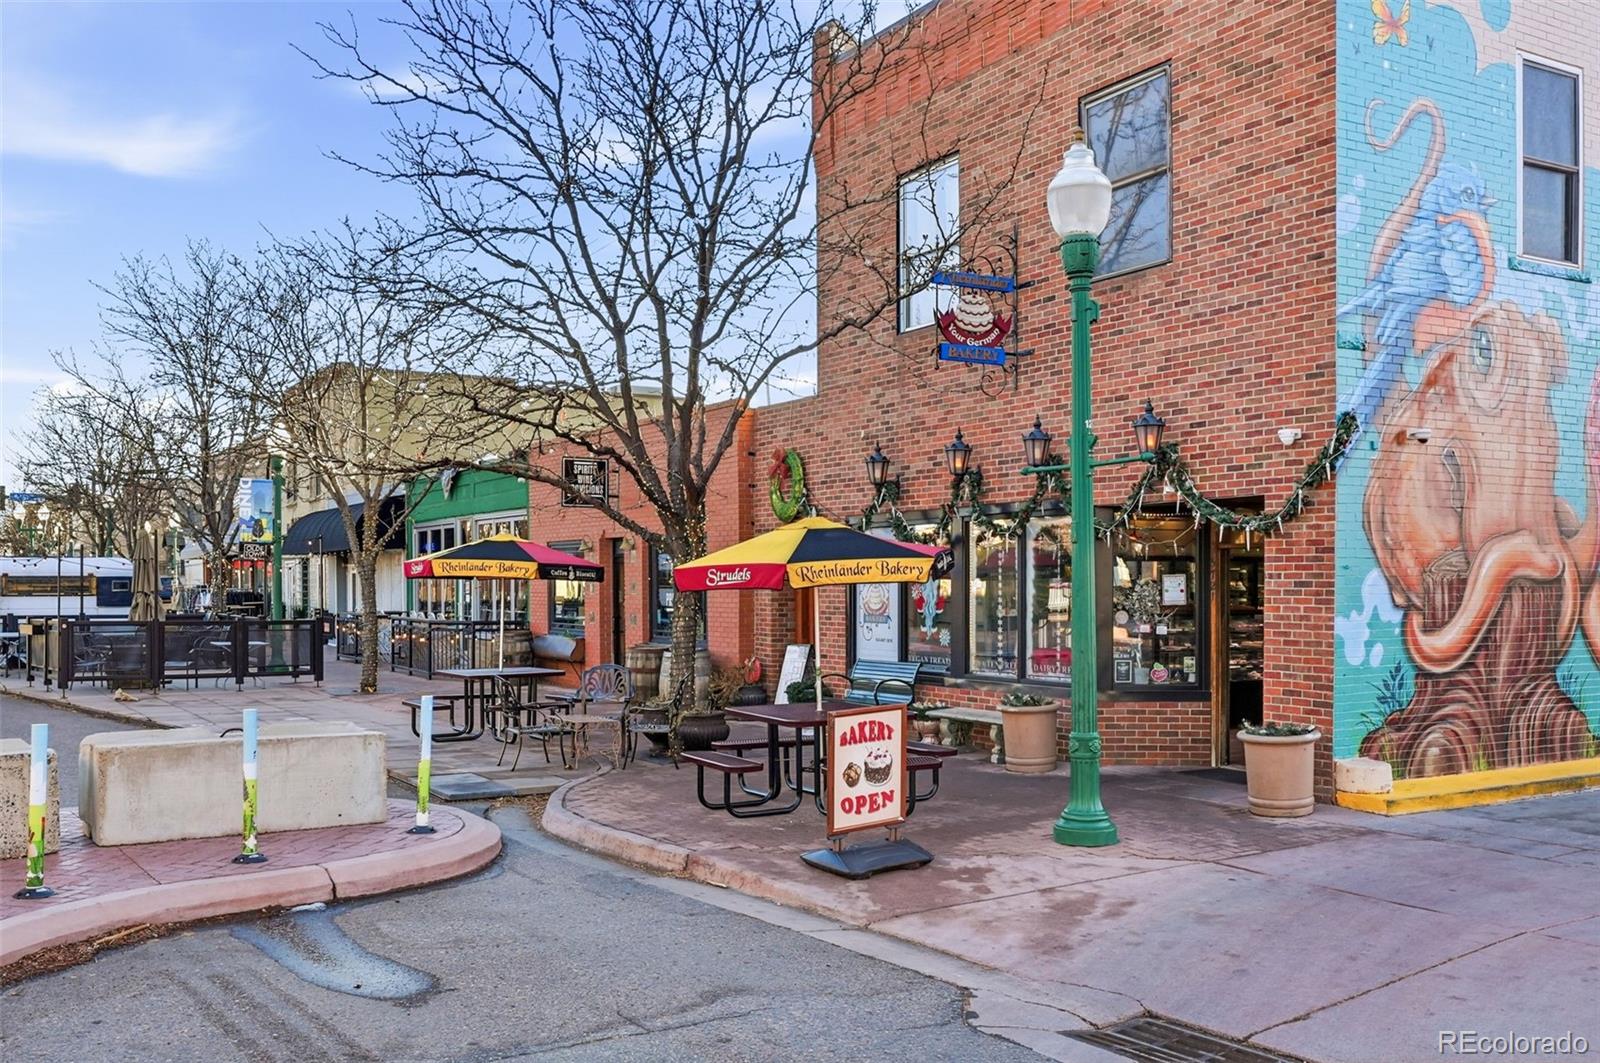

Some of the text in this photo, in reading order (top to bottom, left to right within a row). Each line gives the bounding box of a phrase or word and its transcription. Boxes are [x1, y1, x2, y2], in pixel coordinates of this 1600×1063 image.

[948, 322, 1001, 347] Your German
[948, 347, 999, 359] BAKERY
[577, 474, 593, 484] WINE
[239, 478, 252, 517] DINE
[495, 562, 530, 577] Bakery
[706, 567, 751, 586] Strudels
[876, 560, 924, 580] Bakery
[1033, 663, 1055, 673] DAIRY
[840, 720, 894, 747] BAKERY
[840, 789, 895, 815] OPEN
